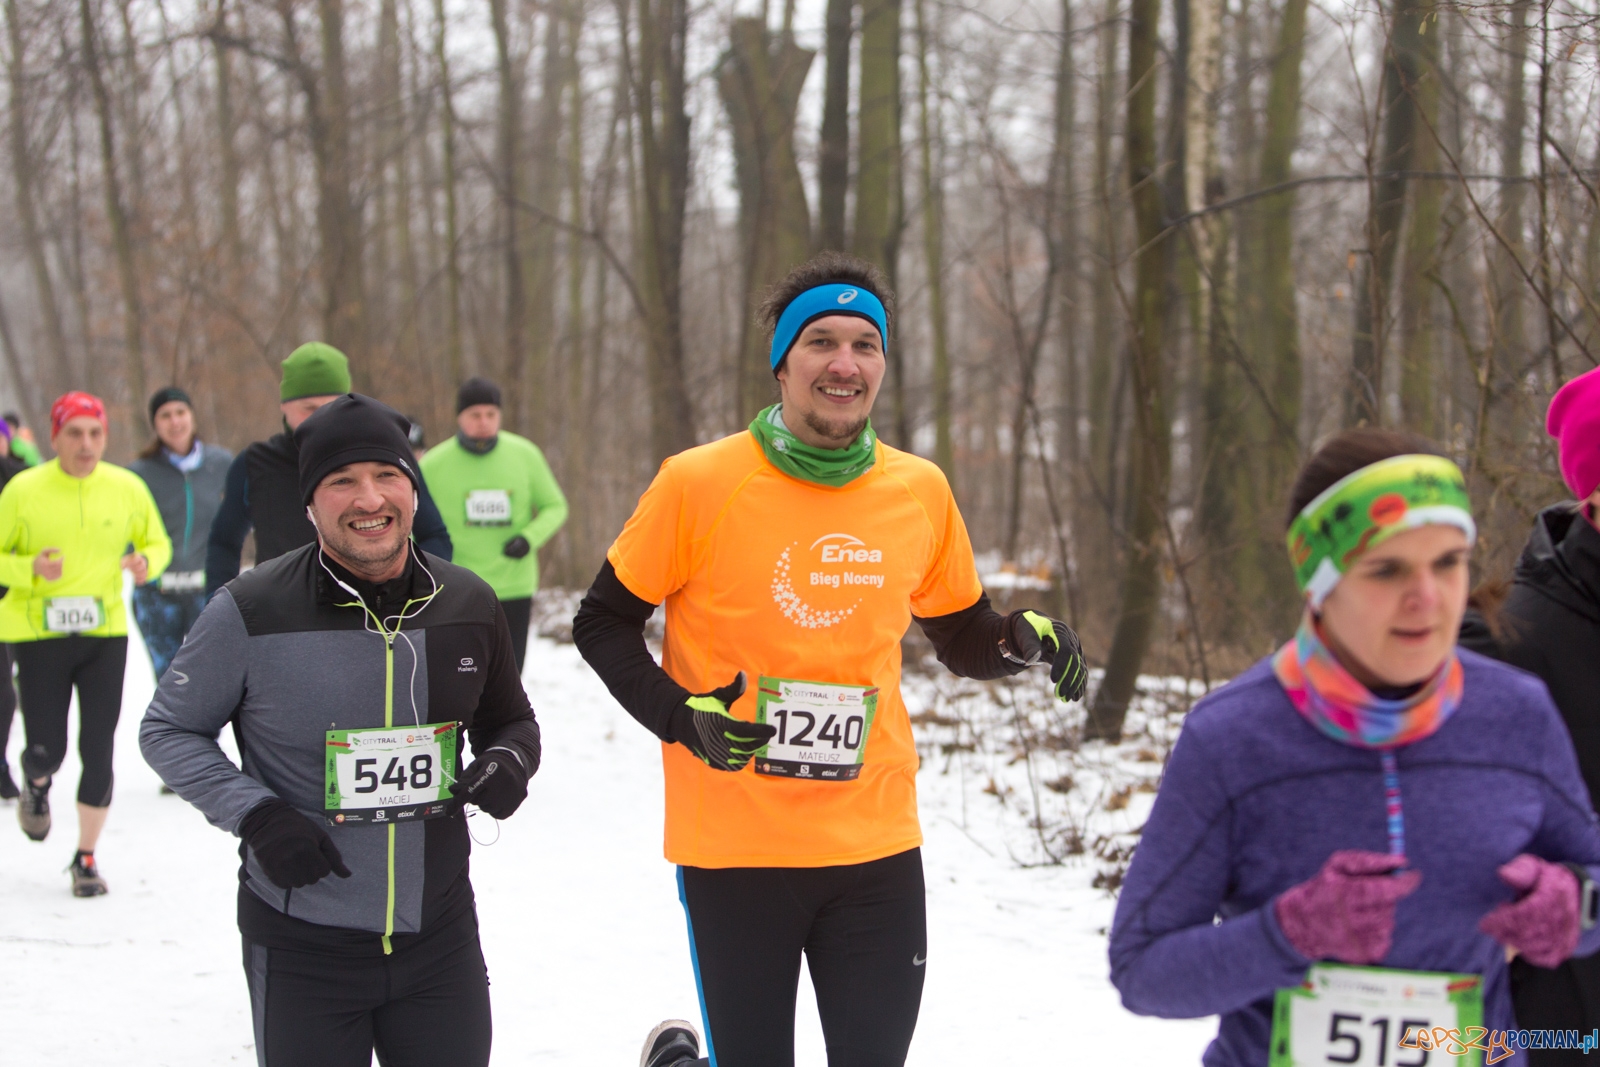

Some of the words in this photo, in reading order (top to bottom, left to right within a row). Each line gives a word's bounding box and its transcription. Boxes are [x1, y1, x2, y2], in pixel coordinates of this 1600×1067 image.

[821, 544, 882, 562] Enea
[810, 572, 840, 588] Bieg
[844, 572, 884, 588] Nocny
[56, 608, 94, 624] 304
[774, 710, 864, 750] 1240
[798, 751, 840, 762] MATEUSZ
[354, 754, 432, 794] 548
[378, 795, 410, 806] MACIEJ
[1326, 1012, 1430, 1067] 515
